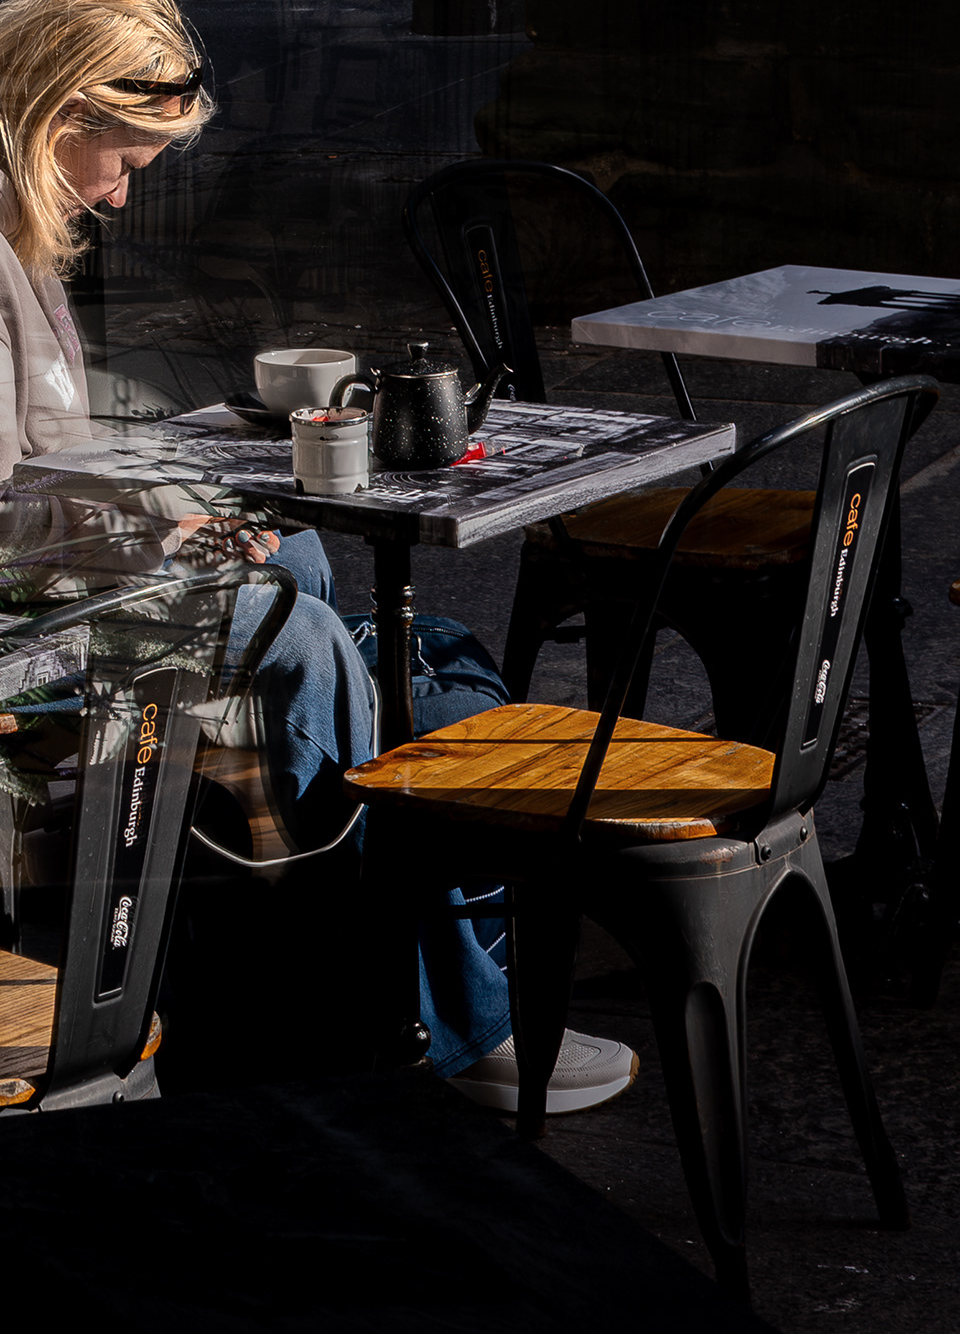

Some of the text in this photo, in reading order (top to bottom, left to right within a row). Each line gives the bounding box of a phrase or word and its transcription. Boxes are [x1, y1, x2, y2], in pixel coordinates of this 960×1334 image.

[477, 249, 495, 293] cafe
[830, 493, 862, 618] cafe Edinburgh
[123, 702, 159, 848] cafe Edinburgh
